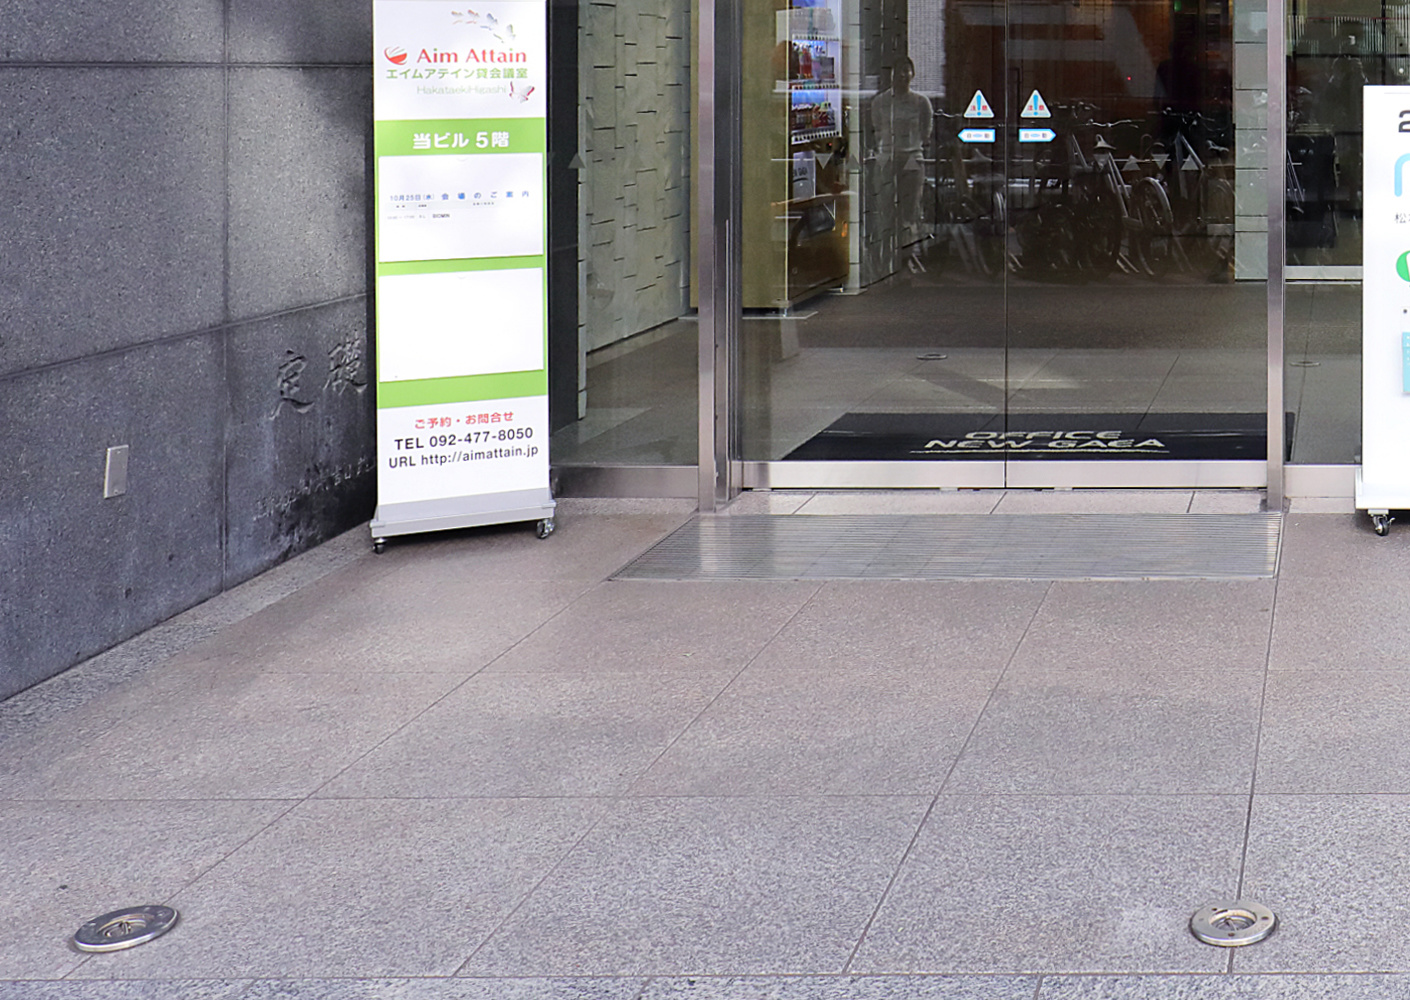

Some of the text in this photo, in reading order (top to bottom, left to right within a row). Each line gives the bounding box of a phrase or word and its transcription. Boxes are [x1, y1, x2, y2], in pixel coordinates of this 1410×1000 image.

[417, 47, 527, 64] Aim Attain
[413, 131, 510, 149] 当ビル 5階
[415, 411, 514, 430] ご予約・お問合せ
[395, 427, 533, 451] TEL 092-477-8050
[924, 438, 1166, 449] NEW GAEA
[965, 430, 1123, 439] OFFICE
[388, 444, 539, 468] URL http://aimattain.jp
